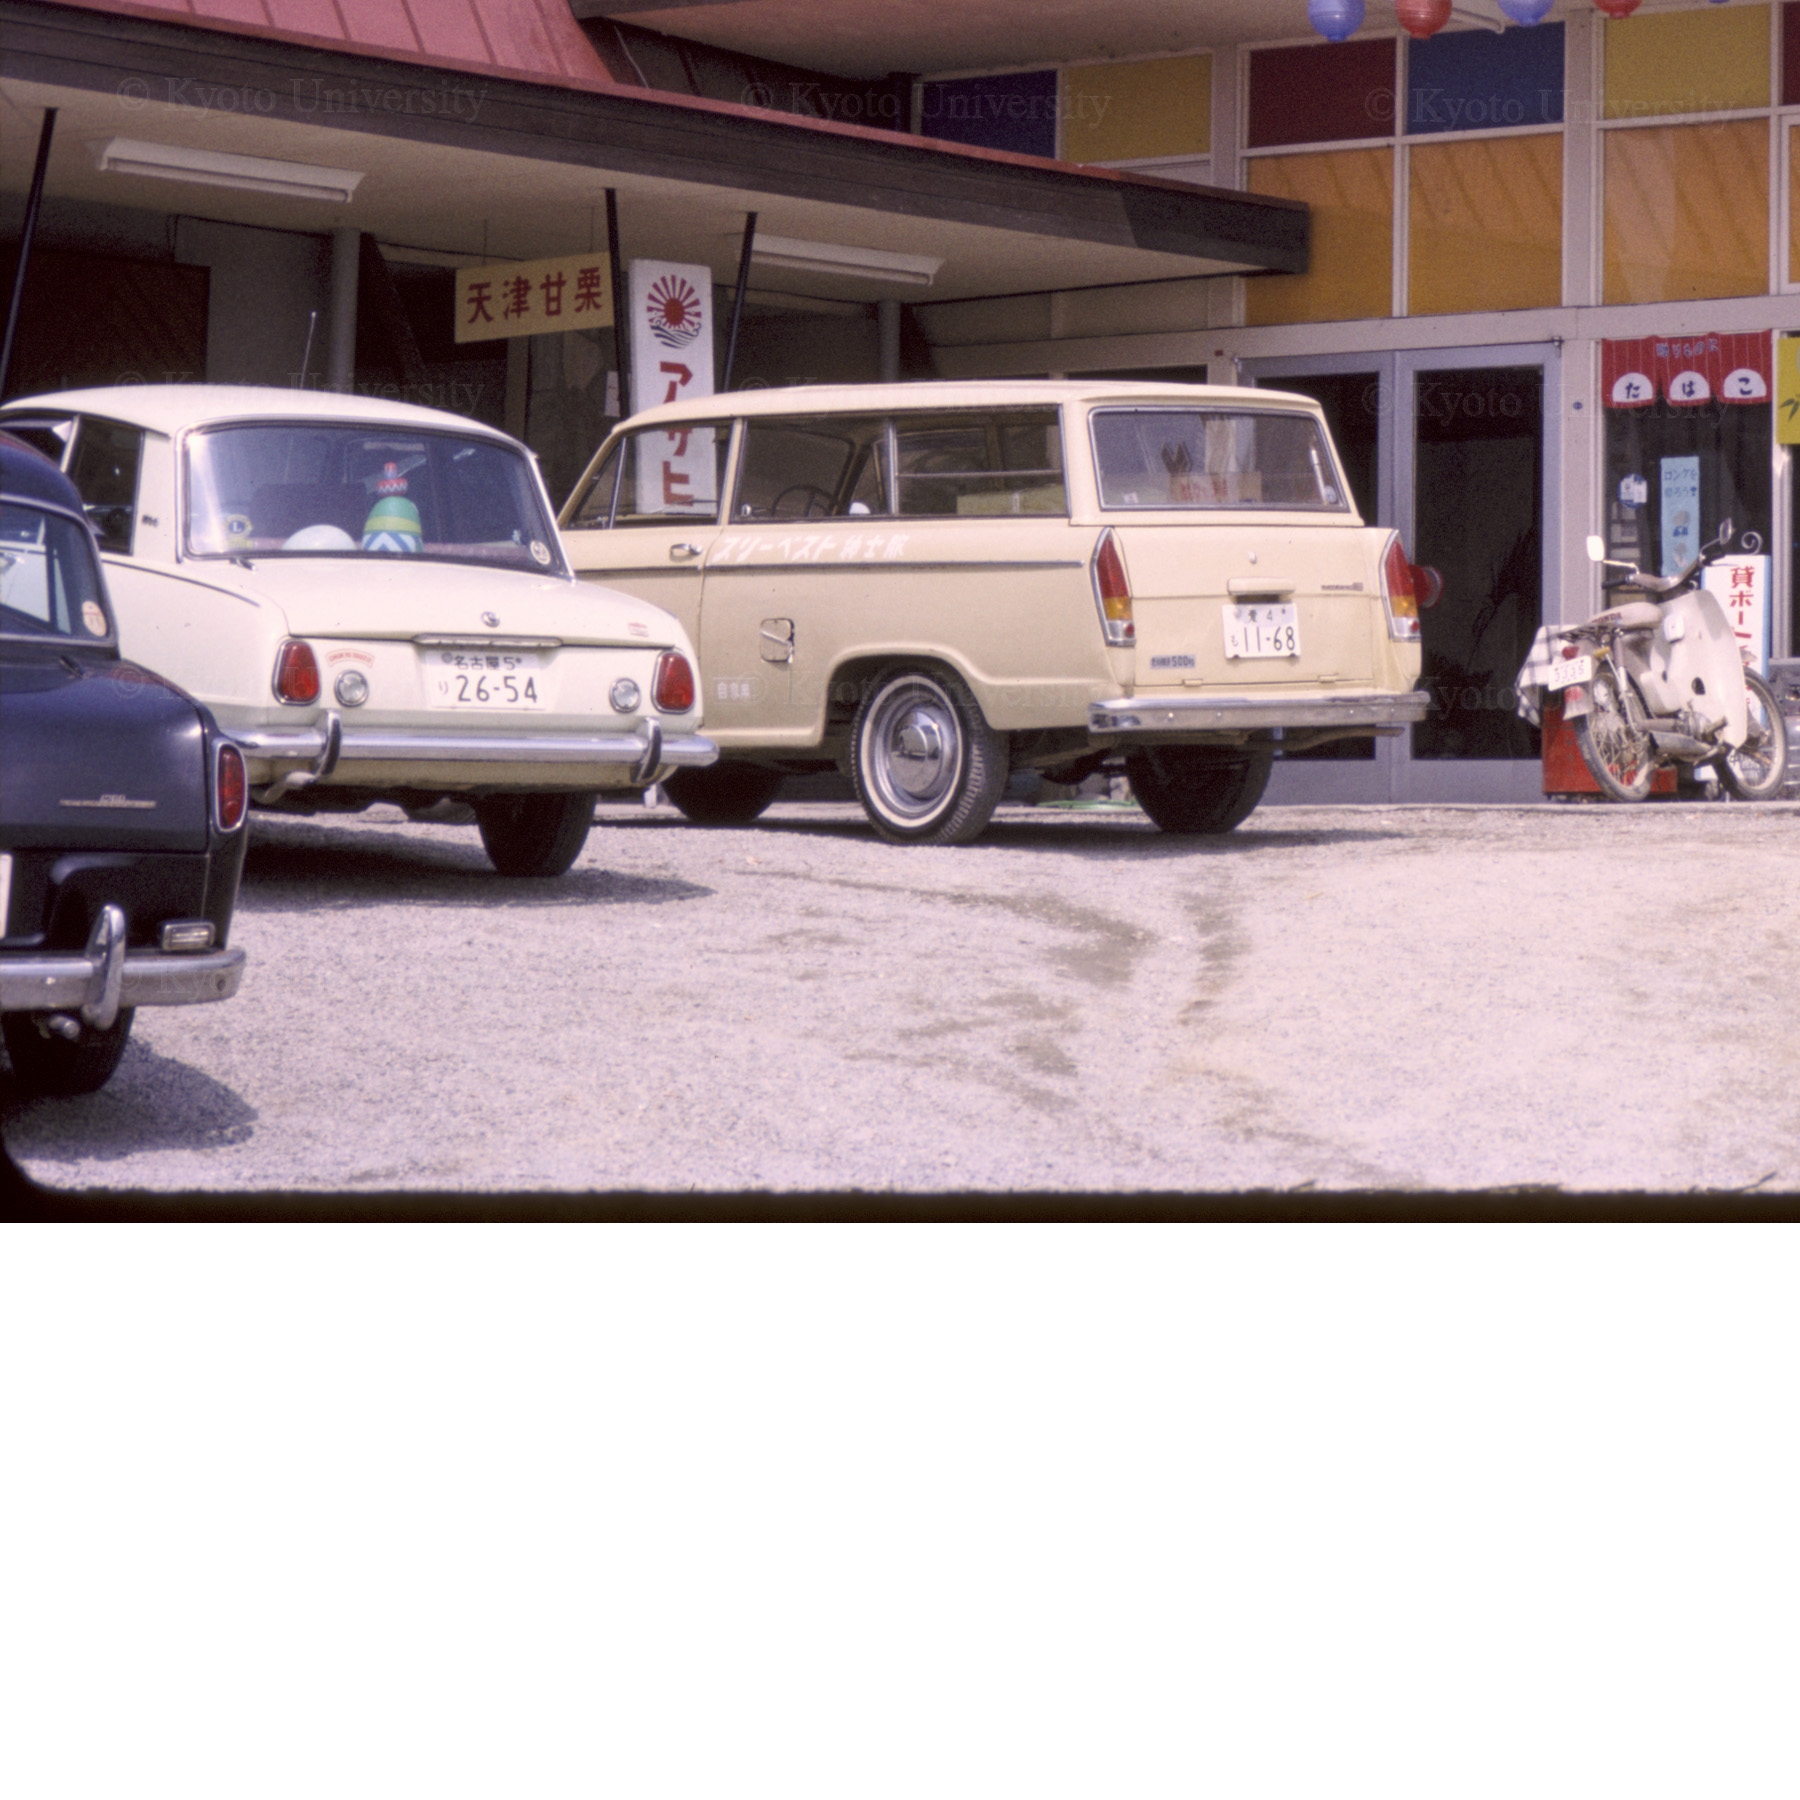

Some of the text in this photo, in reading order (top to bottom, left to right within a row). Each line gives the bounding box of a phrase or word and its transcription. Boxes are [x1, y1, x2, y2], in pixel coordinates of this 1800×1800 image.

[467, 266, 603, 324] 天津甘栗
[1243, 625, 1297, 653] 11-68
[455, 675, 538, 704] 26-54
